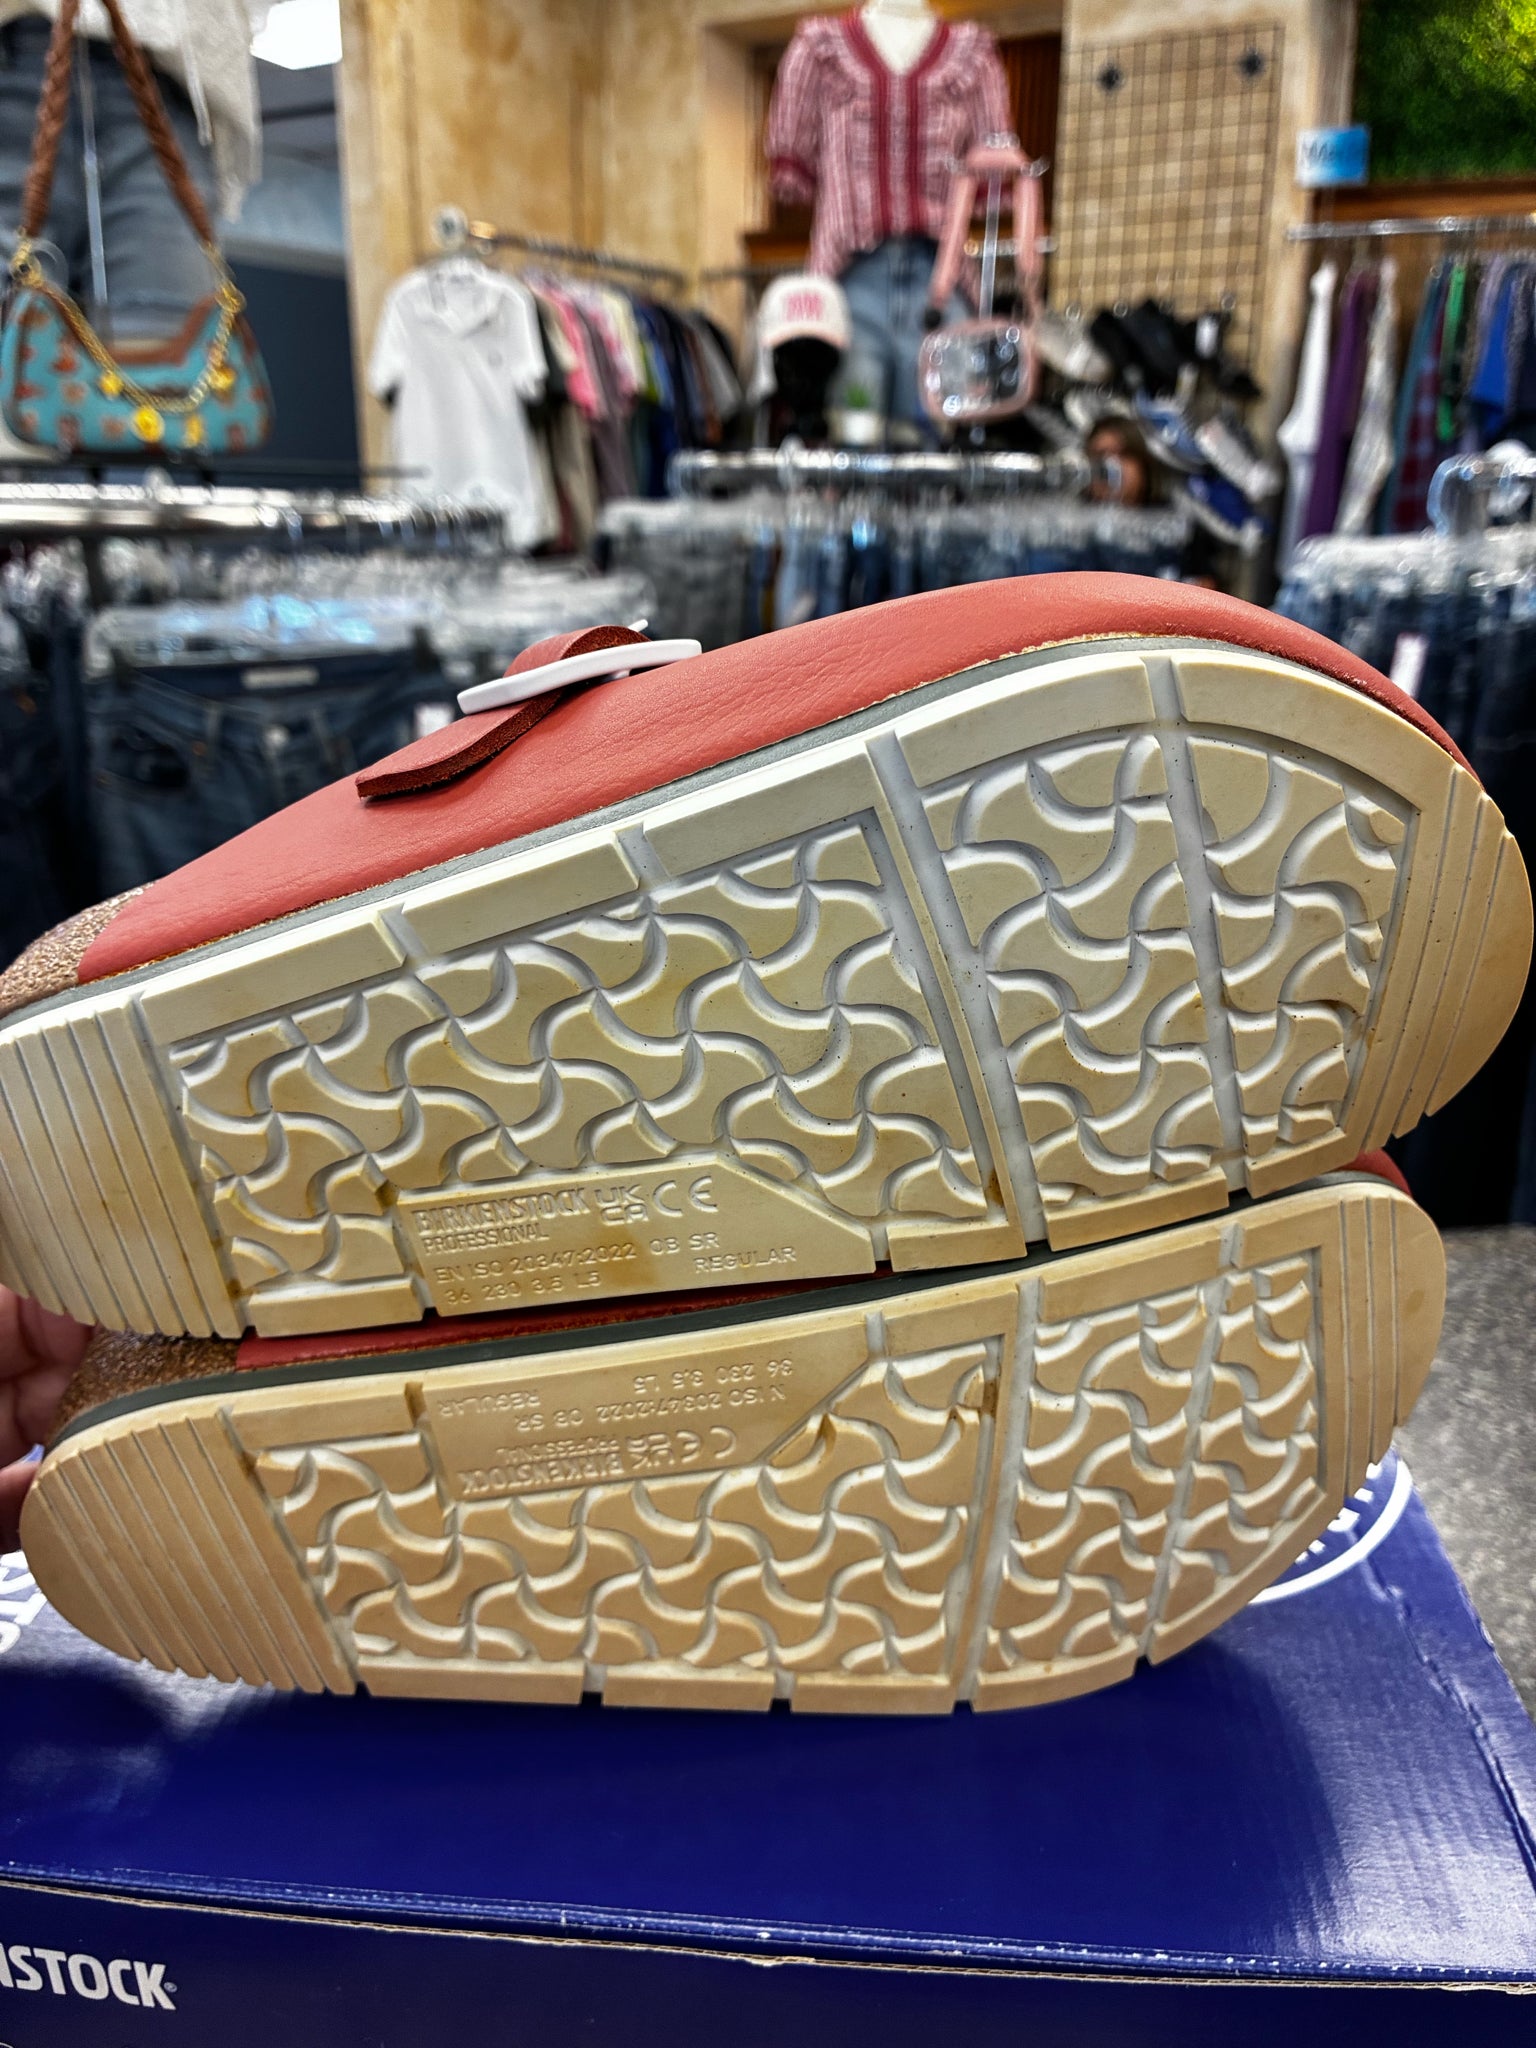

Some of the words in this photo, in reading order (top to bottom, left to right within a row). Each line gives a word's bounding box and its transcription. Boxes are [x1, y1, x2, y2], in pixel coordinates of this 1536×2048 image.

[412, 1188, 591, 1236] BIRKENSTOCK
[422, 1222, 550, 1256] PROFESSIONAL
[434, 1266, 465, 1284] EN
[470, 1261, 504, 1279] ISO
[688, 1232, 719, 1250] SR
[694, 1247, 797, 1273] REGULAR
[444, 1288, 471, 1305] 36
[481, 1281, 527, 1300] 230
[716, 1363, 755, 1385] 230
[767, 1358, 793, 1378] 36
[439, 1390, 541, 1417] REGULAR
[596, 1392, 722, 1422] 20347:2022
[515, 1413, 545, 1432] SR
[457, 1452, 625, 1495] BIRKENSTOCK
